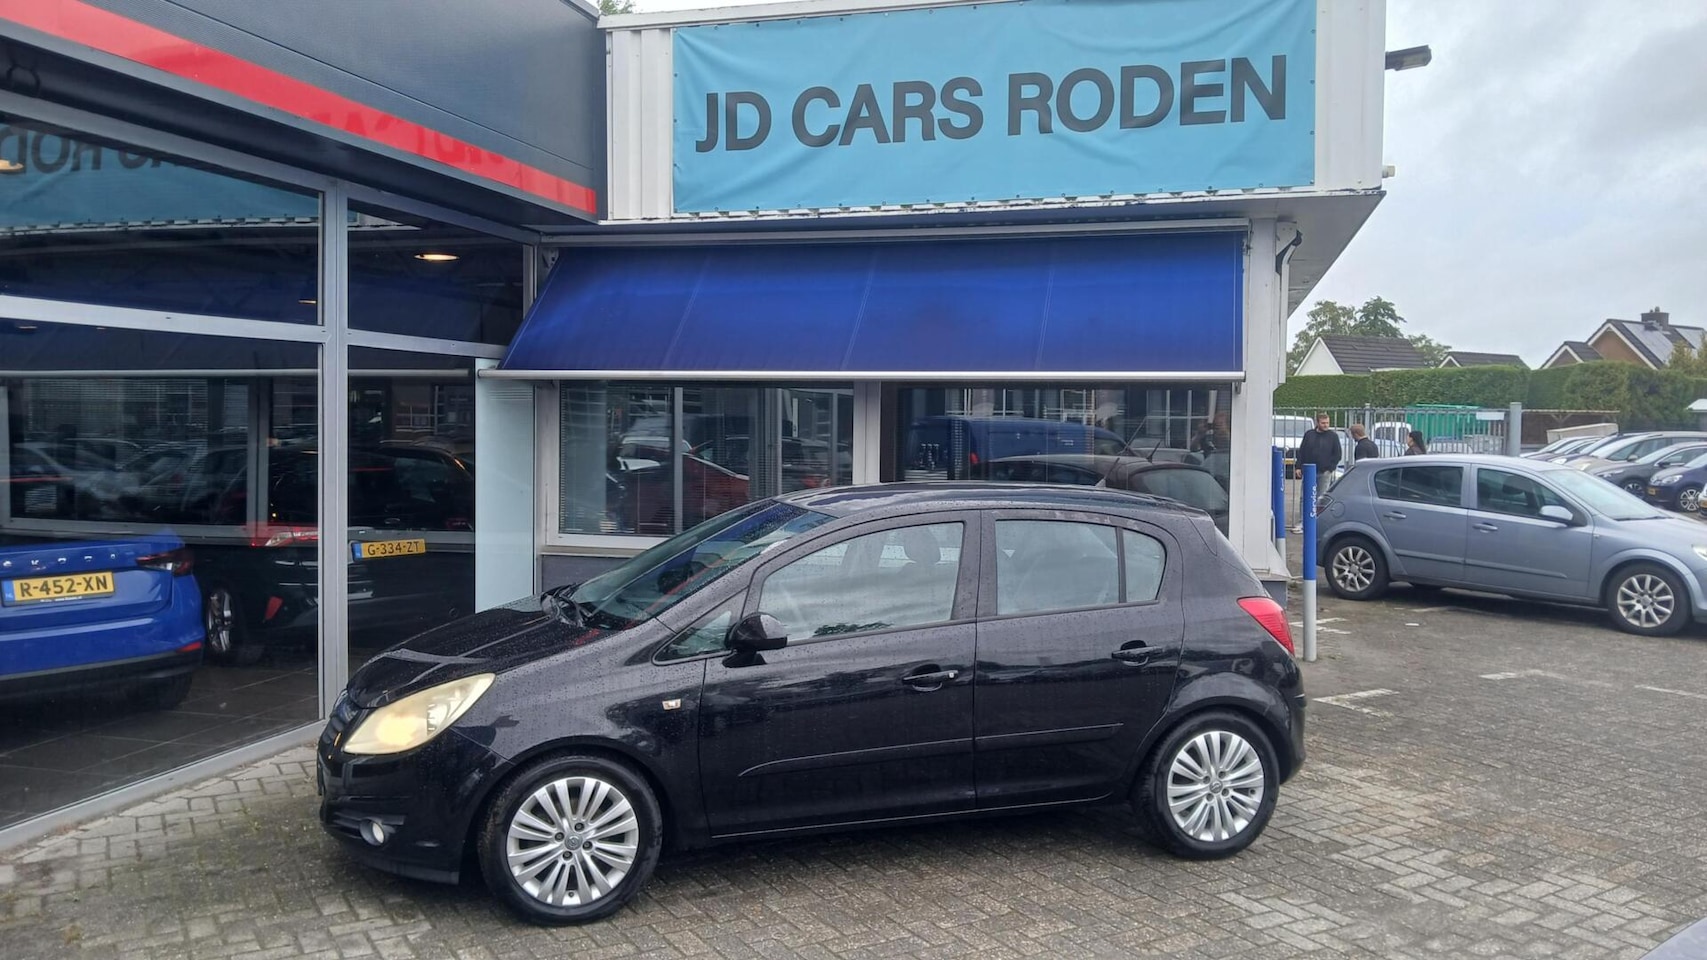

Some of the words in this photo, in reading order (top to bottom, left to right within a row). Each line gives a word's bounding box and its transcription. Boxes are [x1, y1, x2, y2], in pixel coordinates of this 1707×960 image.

[695, 90, 772, 153] JD
[791, 76, 984, 147] CARS
[1007, 54, 1287, 136] RODEN
[1309, 485, 1318, 518] Service
[367, 541, 420, 556] G-334-ZT
[20, 575, 108, 598] R-452-XN
